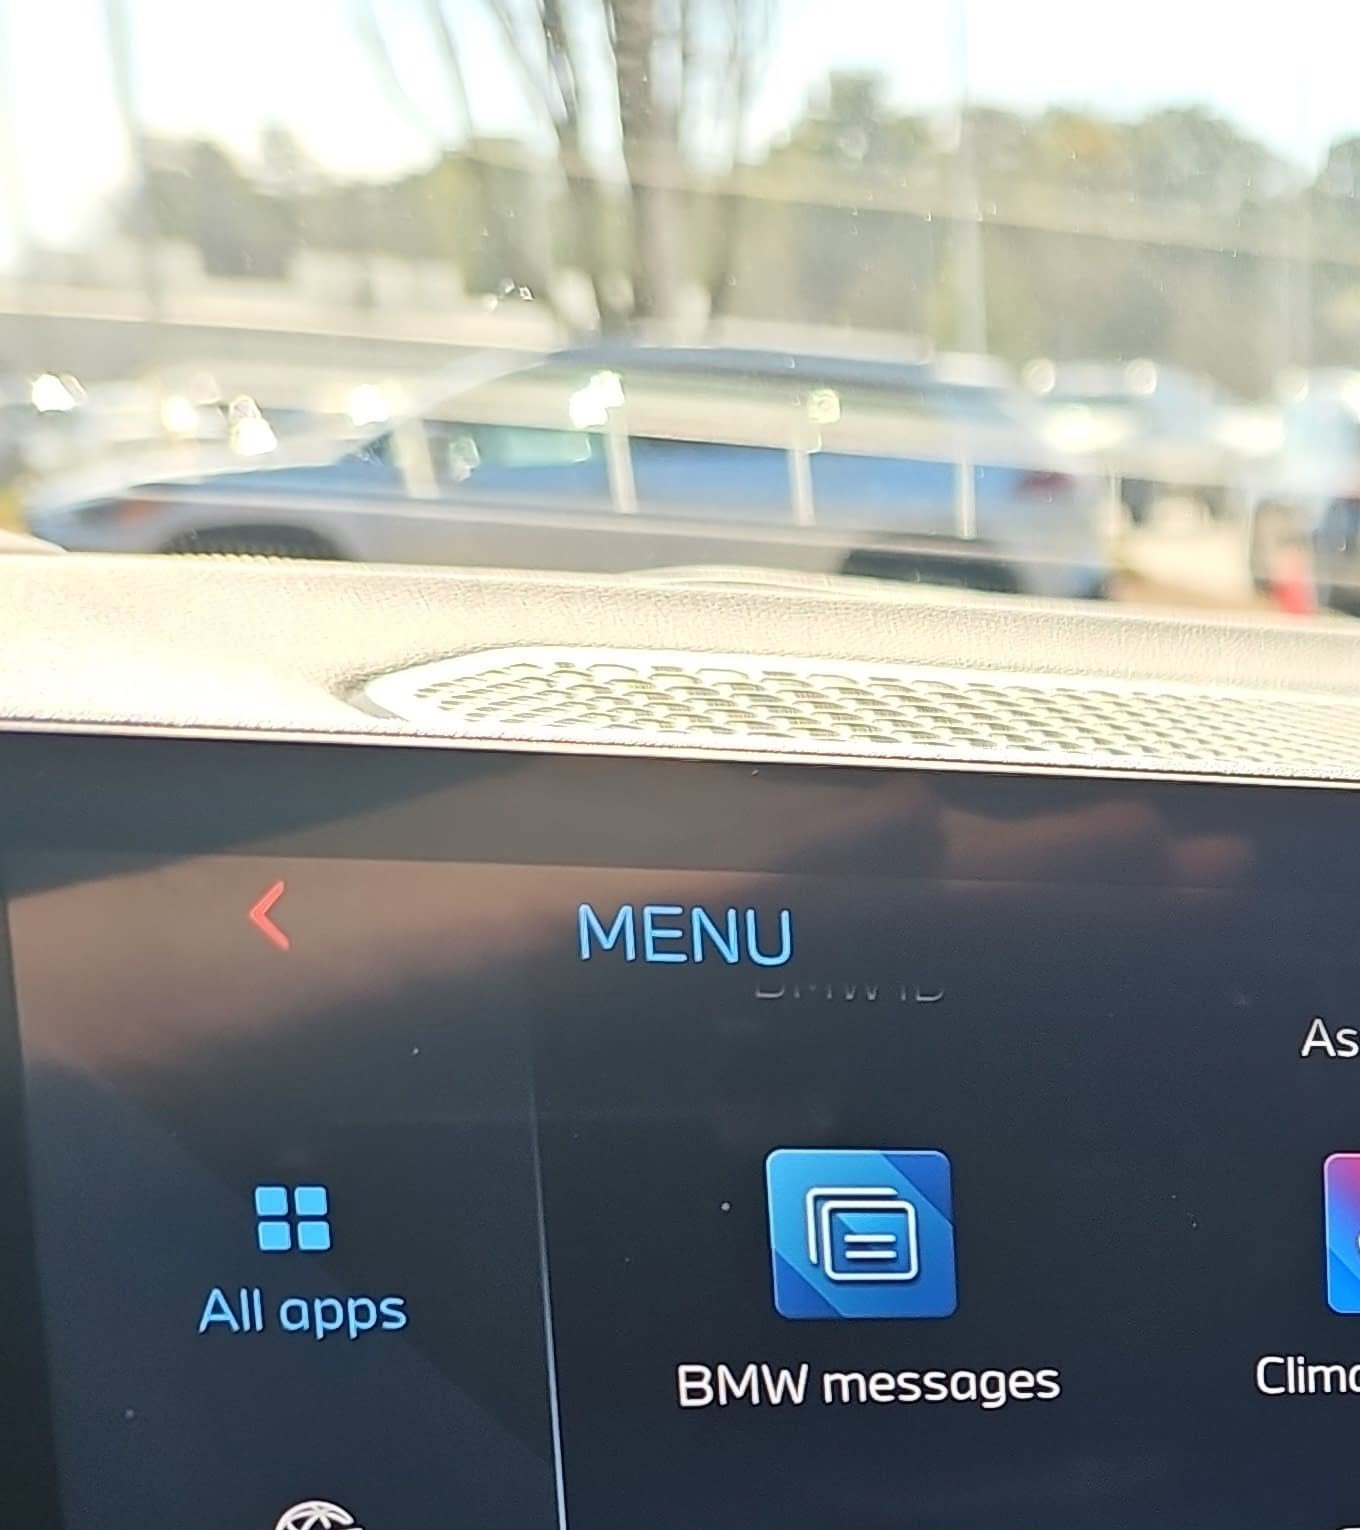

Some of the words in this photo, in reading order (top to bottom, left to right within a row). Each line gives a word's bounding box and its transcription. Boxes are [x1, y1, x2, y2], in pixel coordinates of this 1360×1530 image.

[577, 903, 792, 967] MENU
[198, 1287, 264, 1333] All
[278, 1296, 408, 1341] apps
[677, 1362, 810, 1408] BMW
[822, 1368, 1061, 1410] messages
